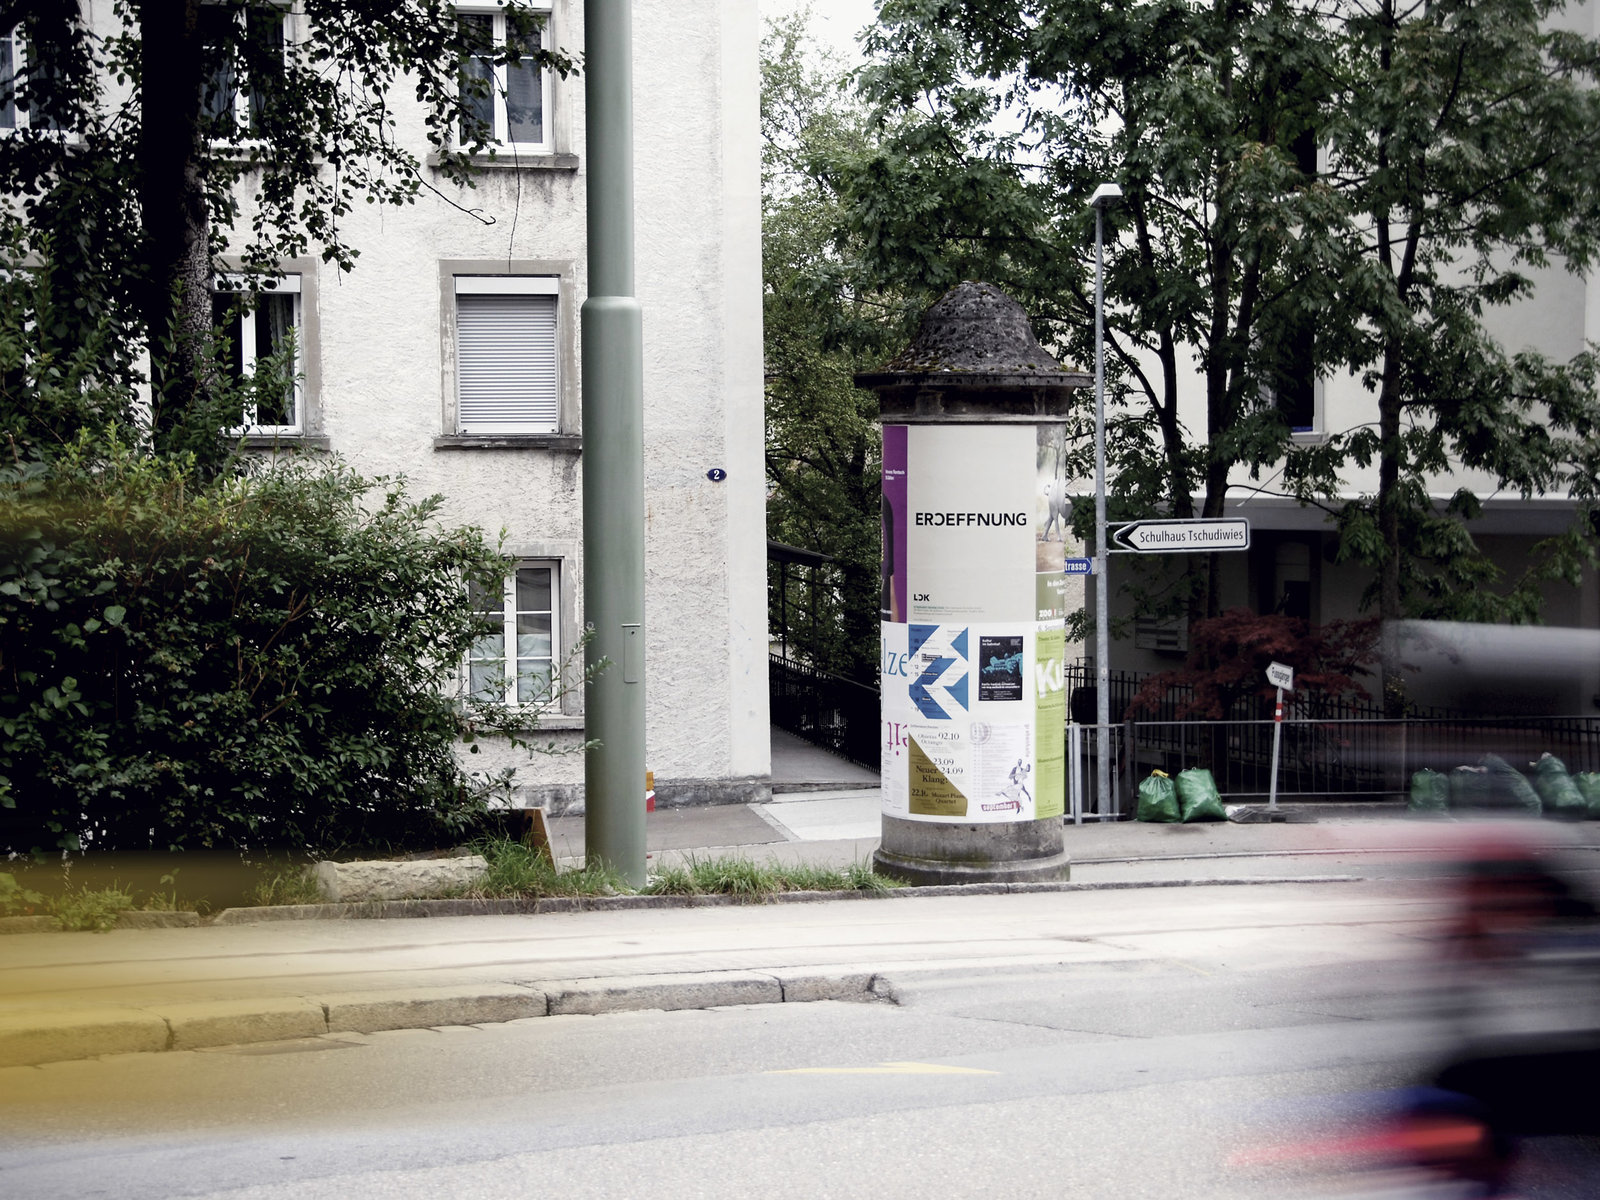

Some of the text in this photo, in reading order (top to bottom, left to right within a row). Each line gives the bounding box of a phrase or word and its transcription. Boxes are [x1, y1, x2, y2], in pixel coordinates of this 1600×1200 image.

[713, 469, 720, 480] 2
[1140, 528, 1244, 543] Schulhaus Tschudiwies
